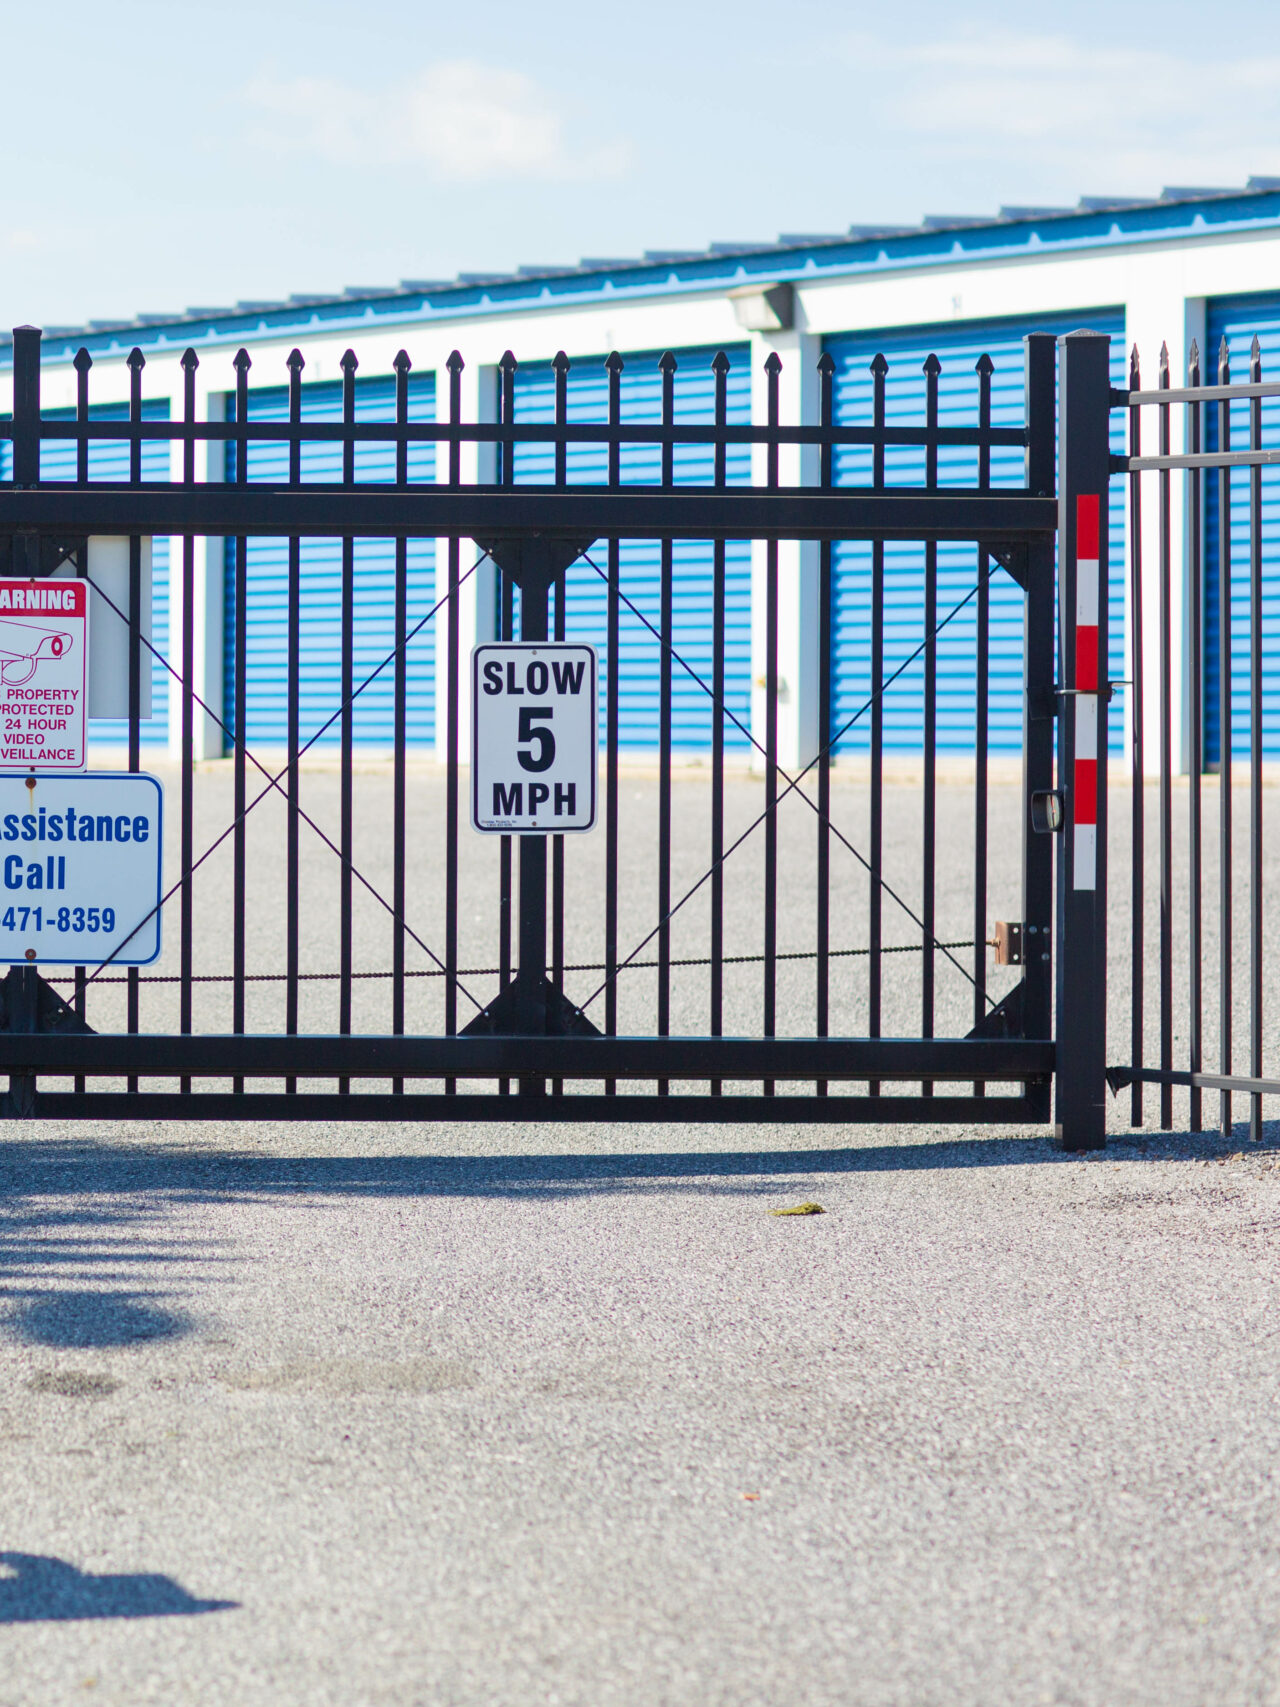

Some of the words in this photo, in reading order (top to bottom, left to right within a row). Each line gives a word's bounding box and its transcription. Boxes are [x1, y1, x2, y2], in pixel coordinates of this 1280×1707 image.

[7, 689, 80, 701] PROPERTY
[482, 661, 586, 695] SLOW
[3, 733, 45, 745] VIDEO
[4, 719, 22, 730] 24
[28, 719, 67, 731] HOUR
[516, 706, 556, 773] 5
[492, 782, 576, 816] MPH
[3, 854, 66, 890] Call
